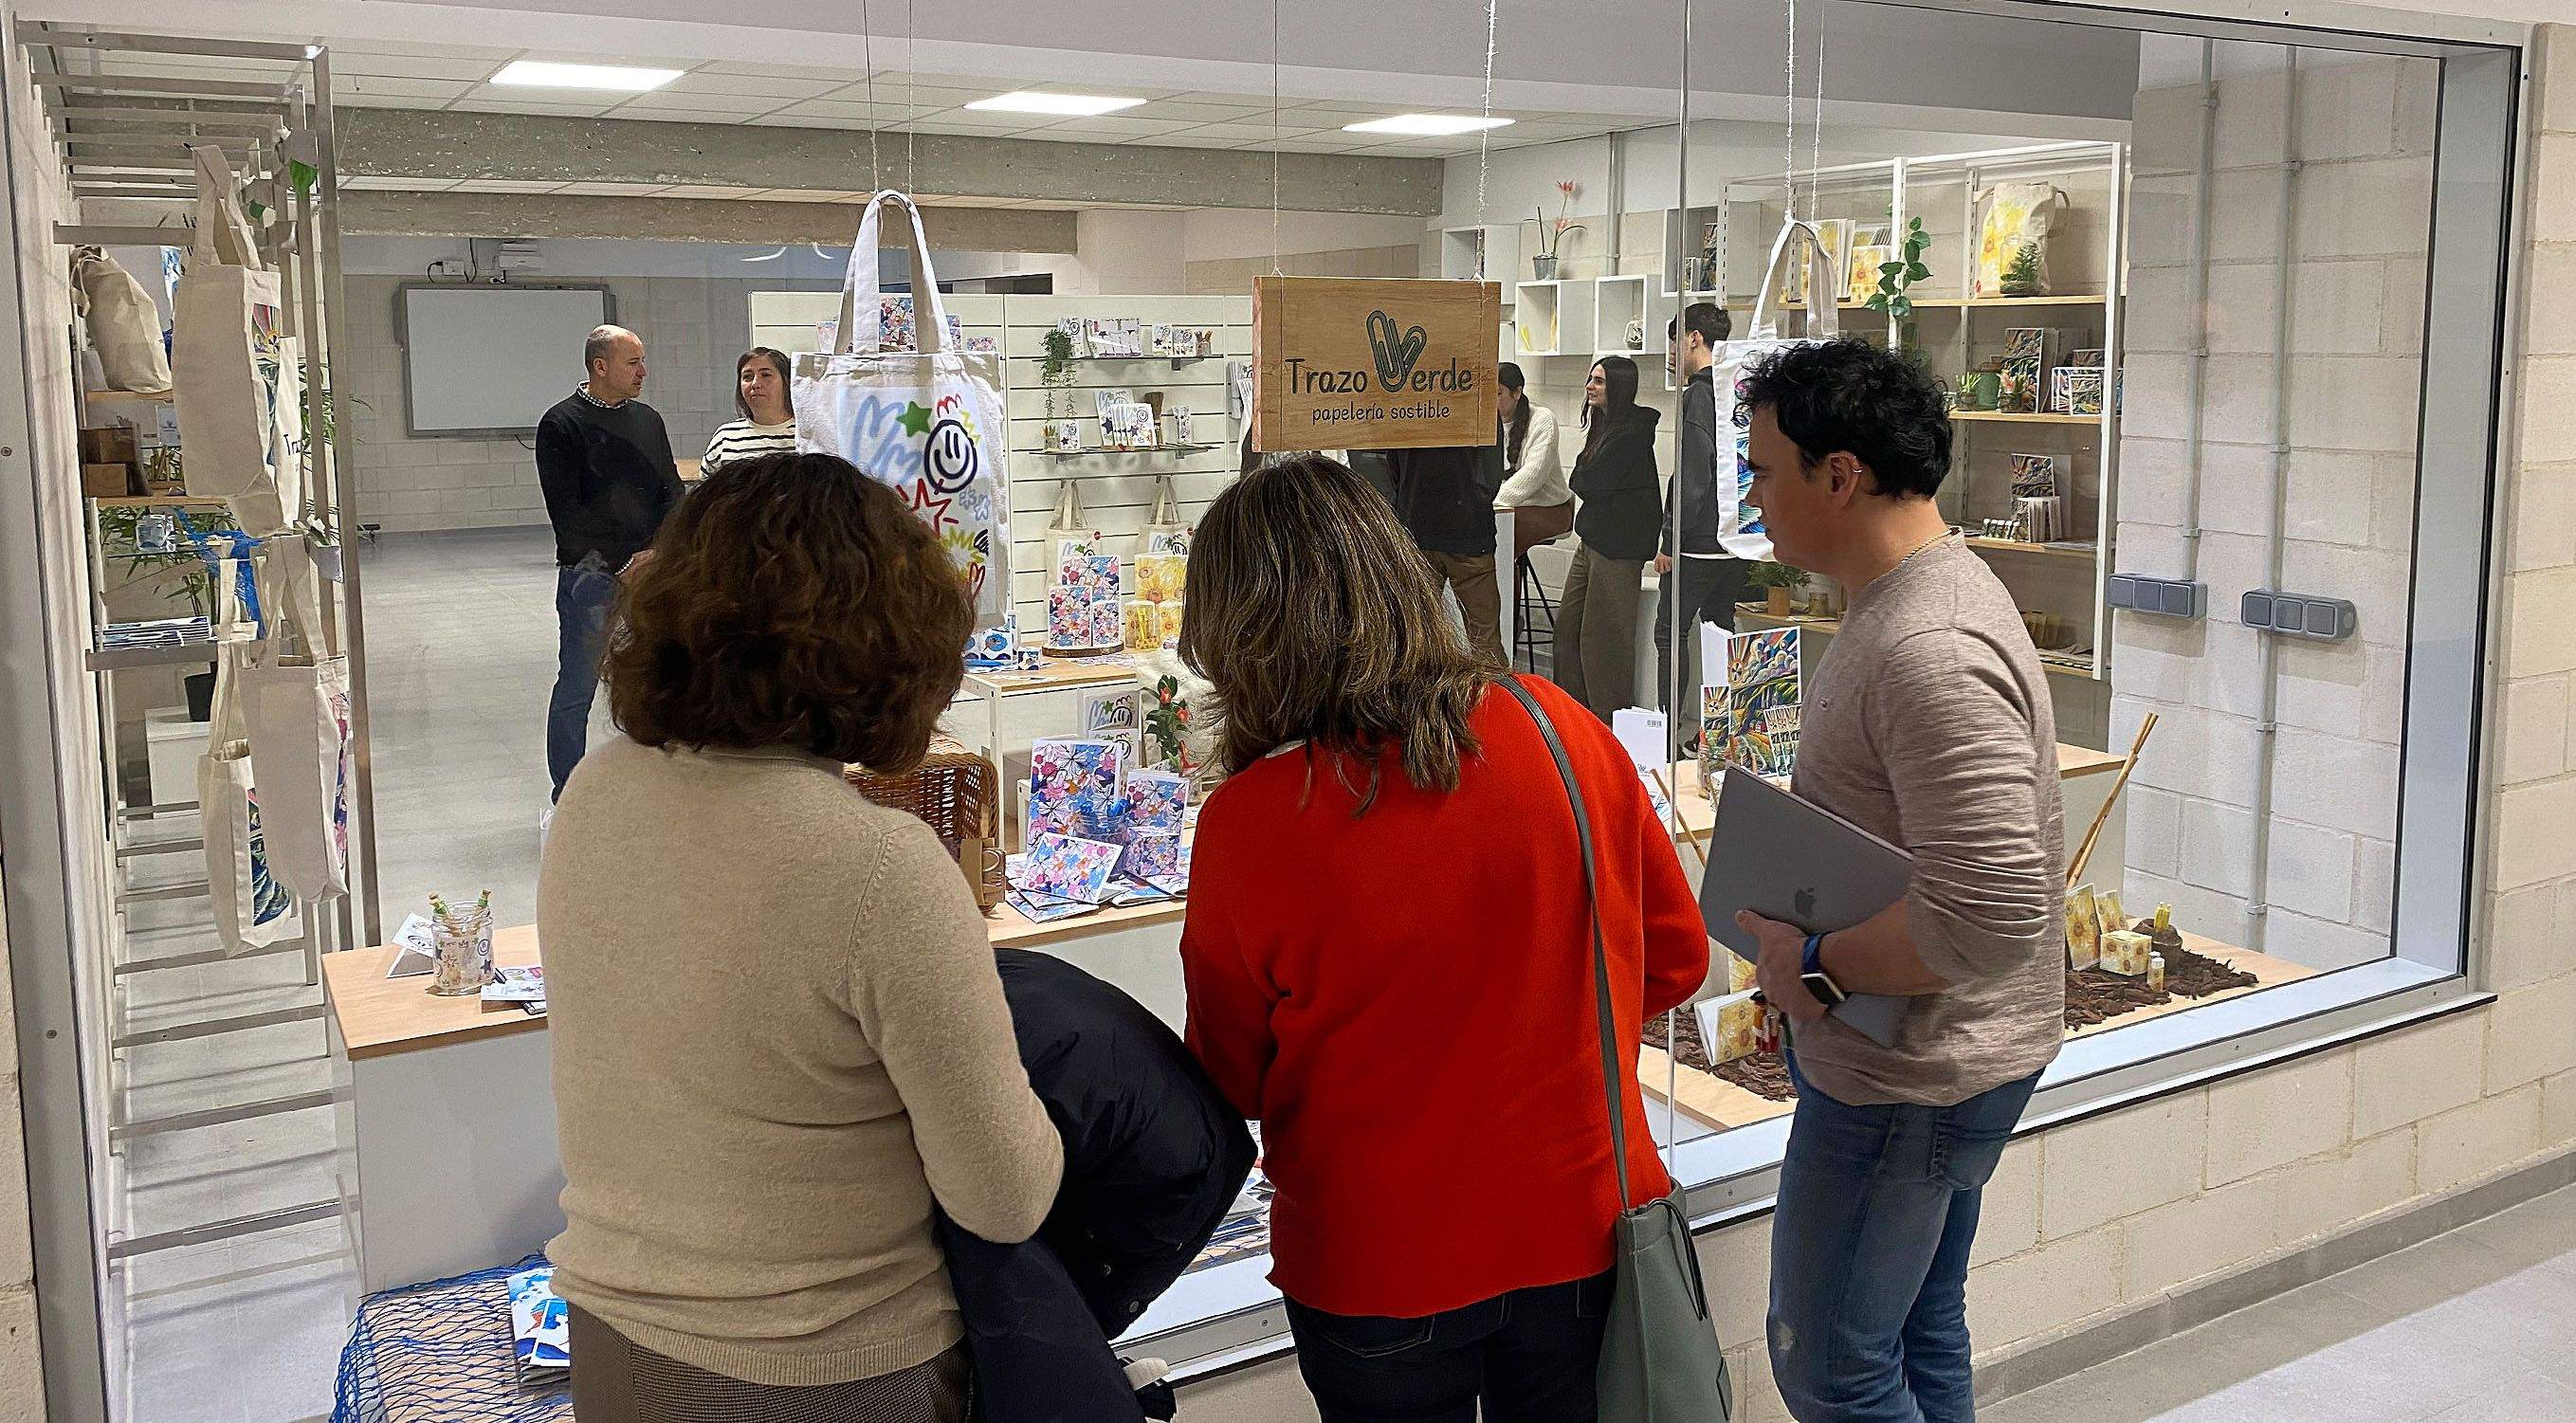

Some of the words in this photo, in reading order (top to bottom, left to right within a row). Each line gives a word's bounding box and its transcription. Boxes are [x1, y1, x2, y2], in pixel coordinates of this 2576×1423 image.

[1285, 357, 1367, 393] Trazo
[1312, 403, 1384, 425] papelería
[1390, 399, 1451, 419] sostible
